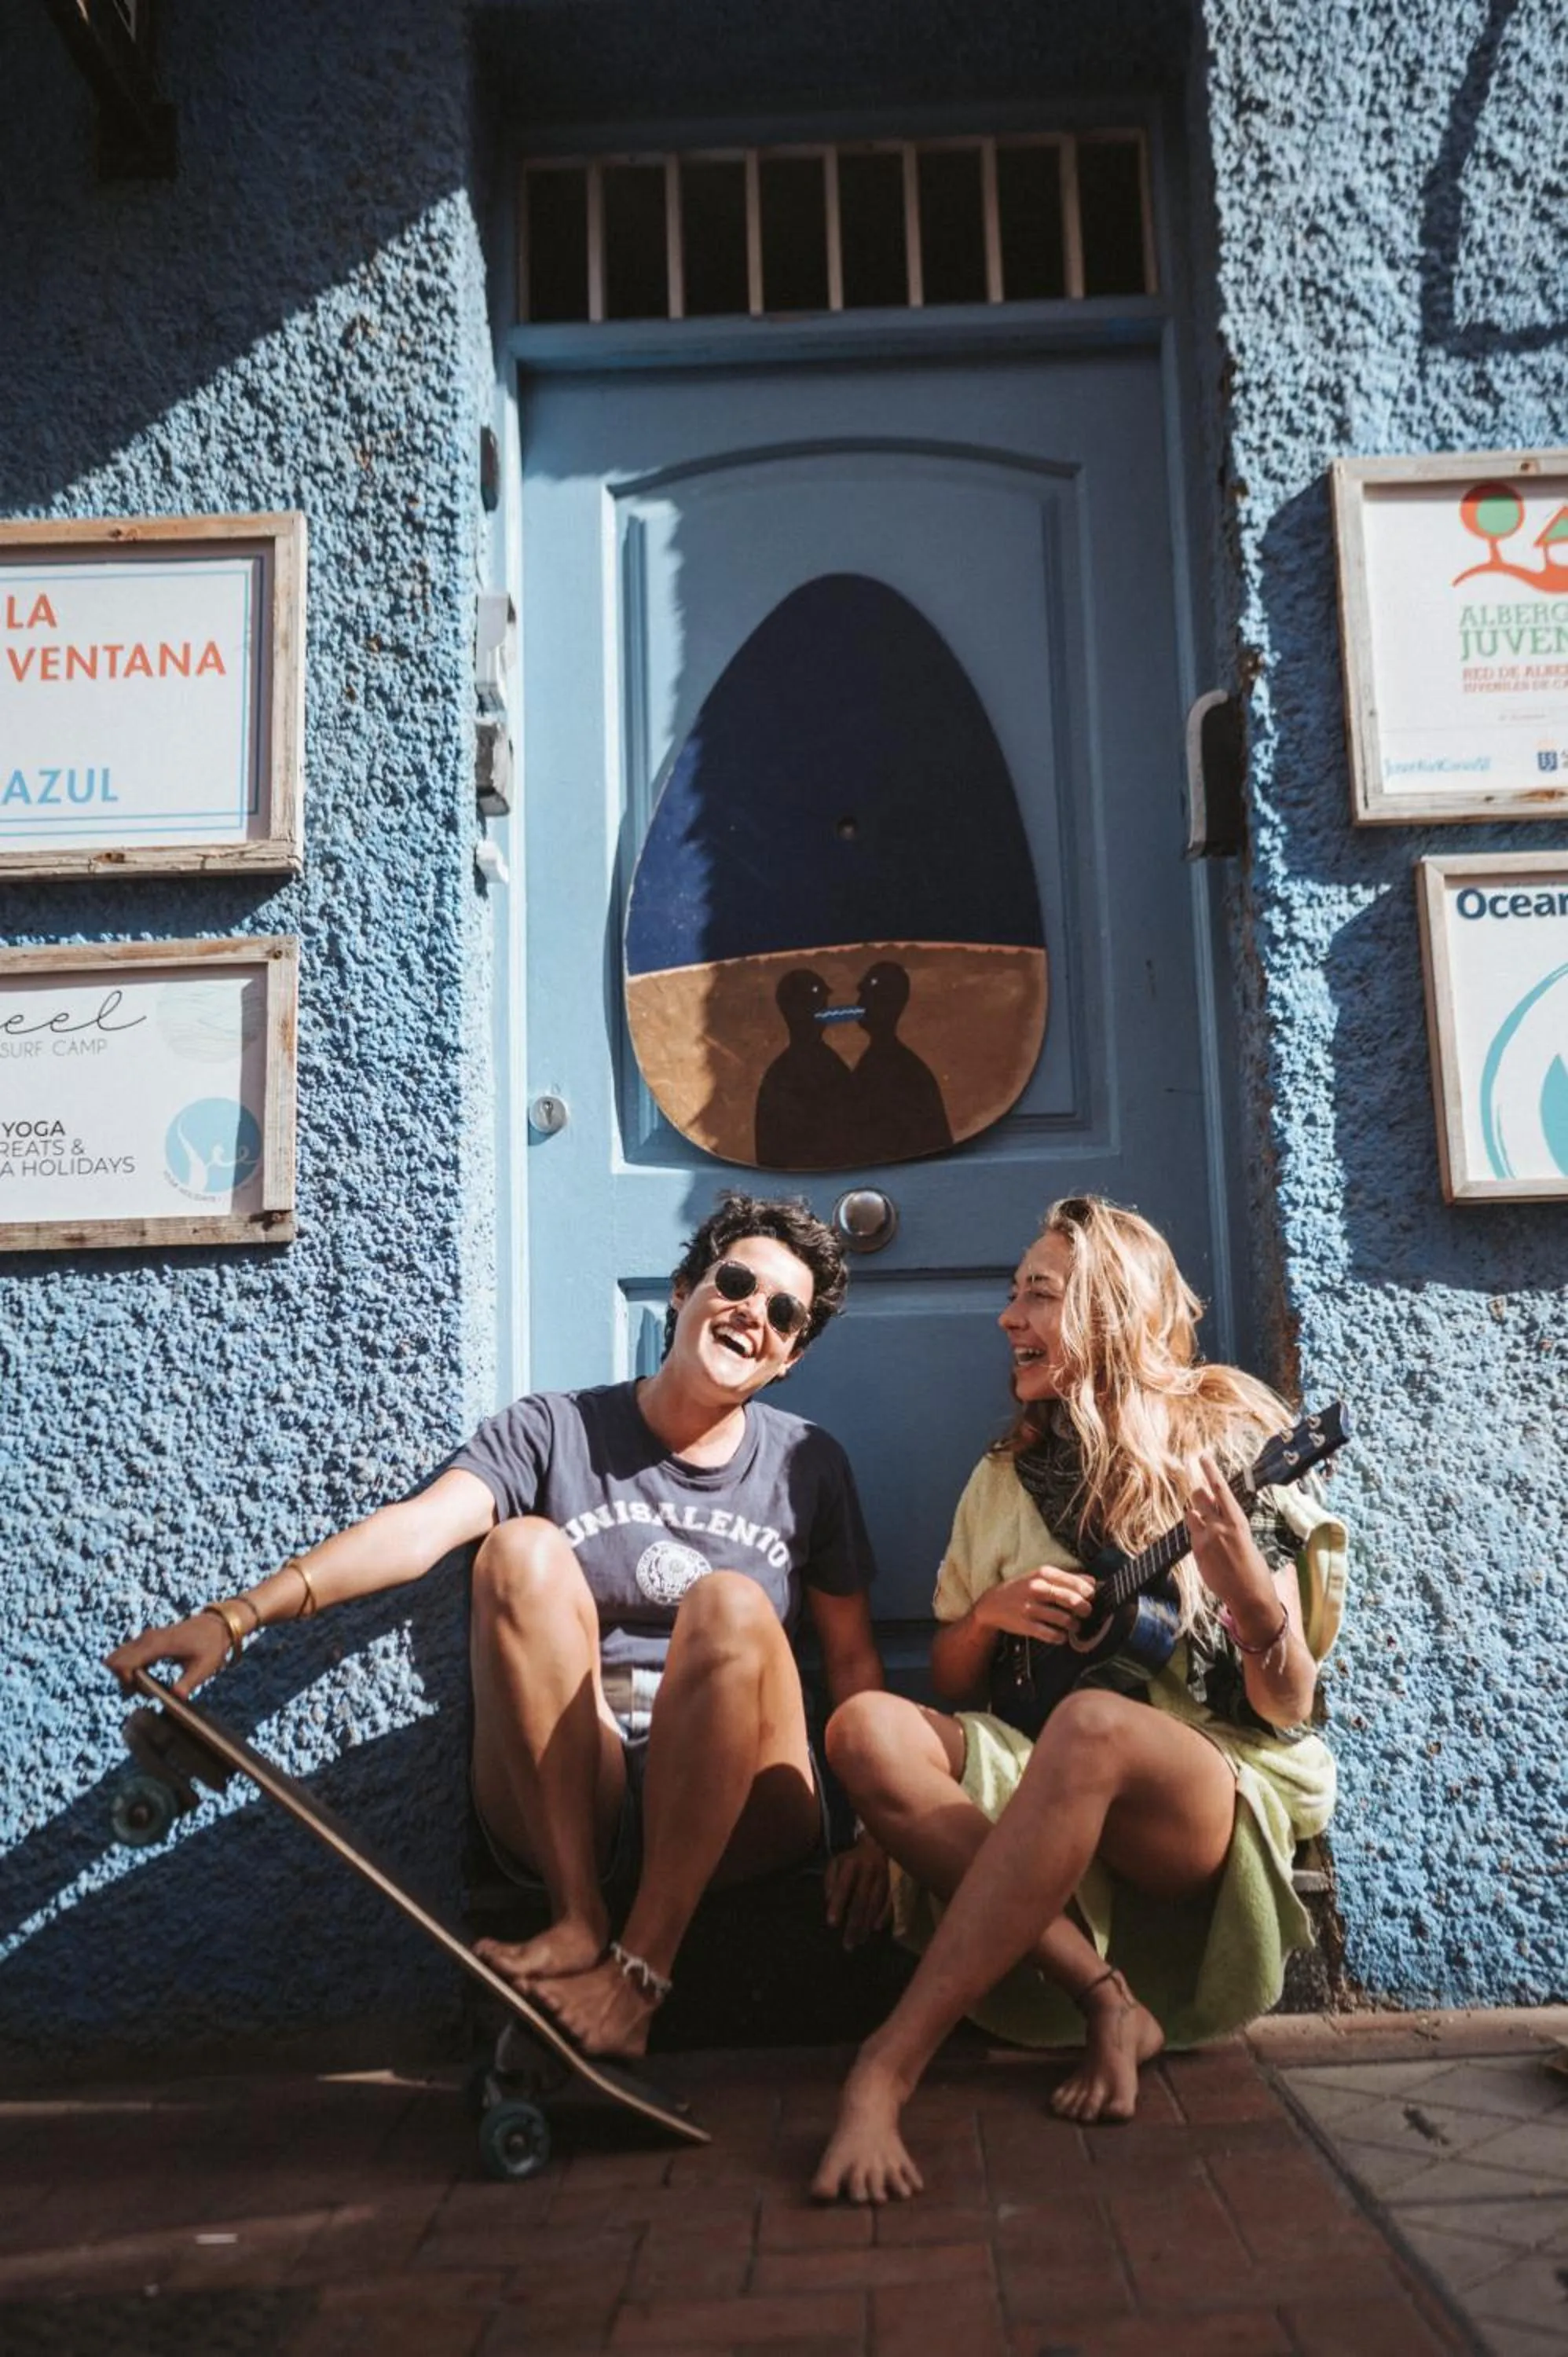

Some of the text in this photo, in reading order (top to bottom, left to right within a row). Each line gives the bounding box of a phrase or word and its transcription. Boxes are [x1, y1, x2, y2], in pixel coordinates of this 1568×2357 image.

[6, 593, 57, 629] LA
[6, 641, 226, 683] VENTANA
[2, 768, 119, 805] AZUL
[0, 1038, 108, 1058] SURF CAMP
[2, 1120, 66, 1138] YOGA
[71, 1138, 85, 1156] &
[0, 1156, 136, 1177] A HOLIDAYS
